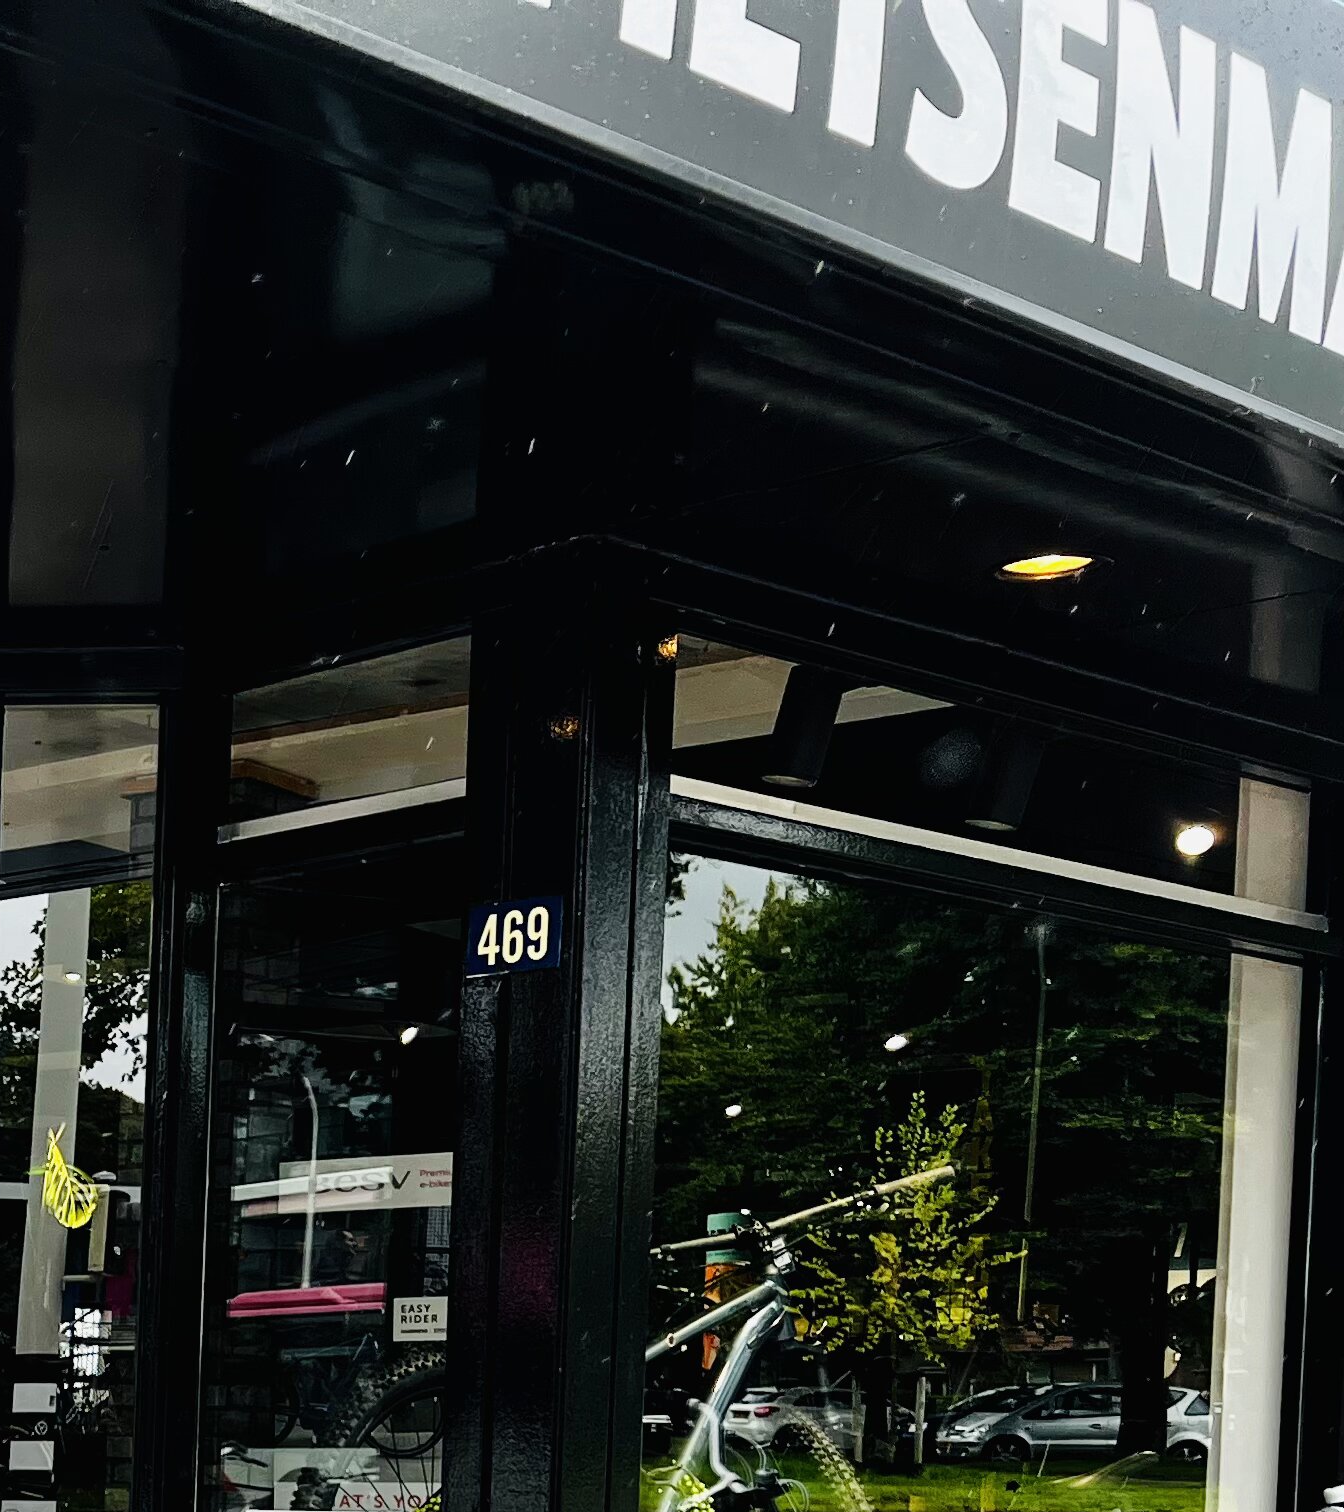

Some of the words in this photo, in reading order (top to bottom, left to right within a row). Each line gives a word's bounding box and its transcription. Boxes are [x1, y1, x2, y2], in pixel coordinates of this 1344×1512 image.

[477, 906, 549, 966] 469
[401, 1304, 431, 1313] EASY
[401, 1314, 438, 1324] RIDER
